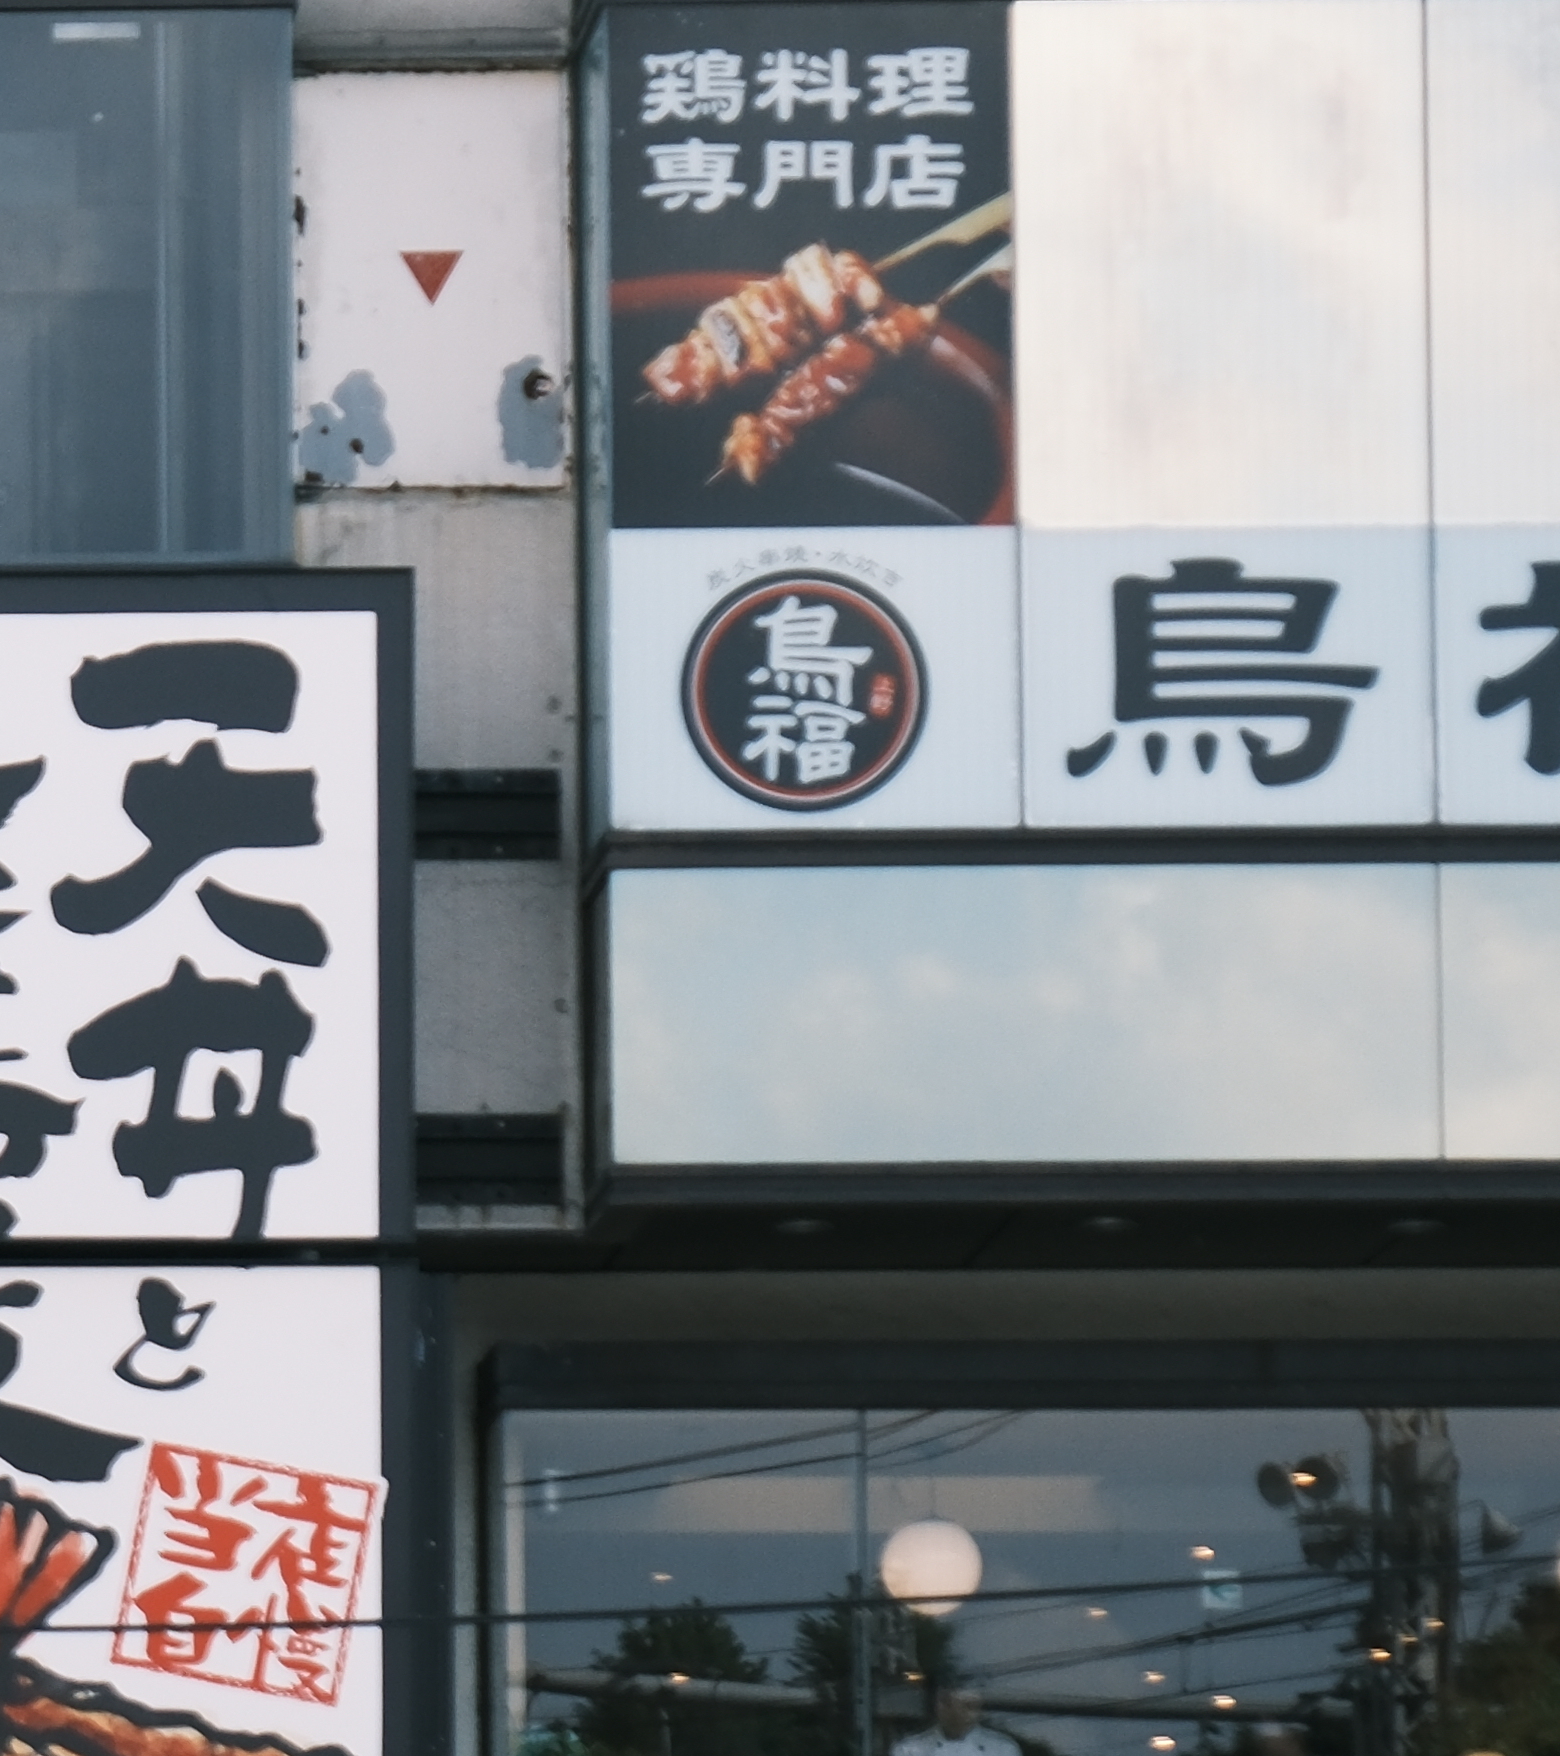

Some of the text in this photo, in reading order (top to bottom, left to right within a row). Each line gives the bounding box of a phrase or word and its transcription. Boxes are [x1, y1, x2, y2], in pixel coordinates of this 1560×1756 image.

[642, 46, 975, 124] 鶏料理
[642, 136, 966, 212] 専門店
